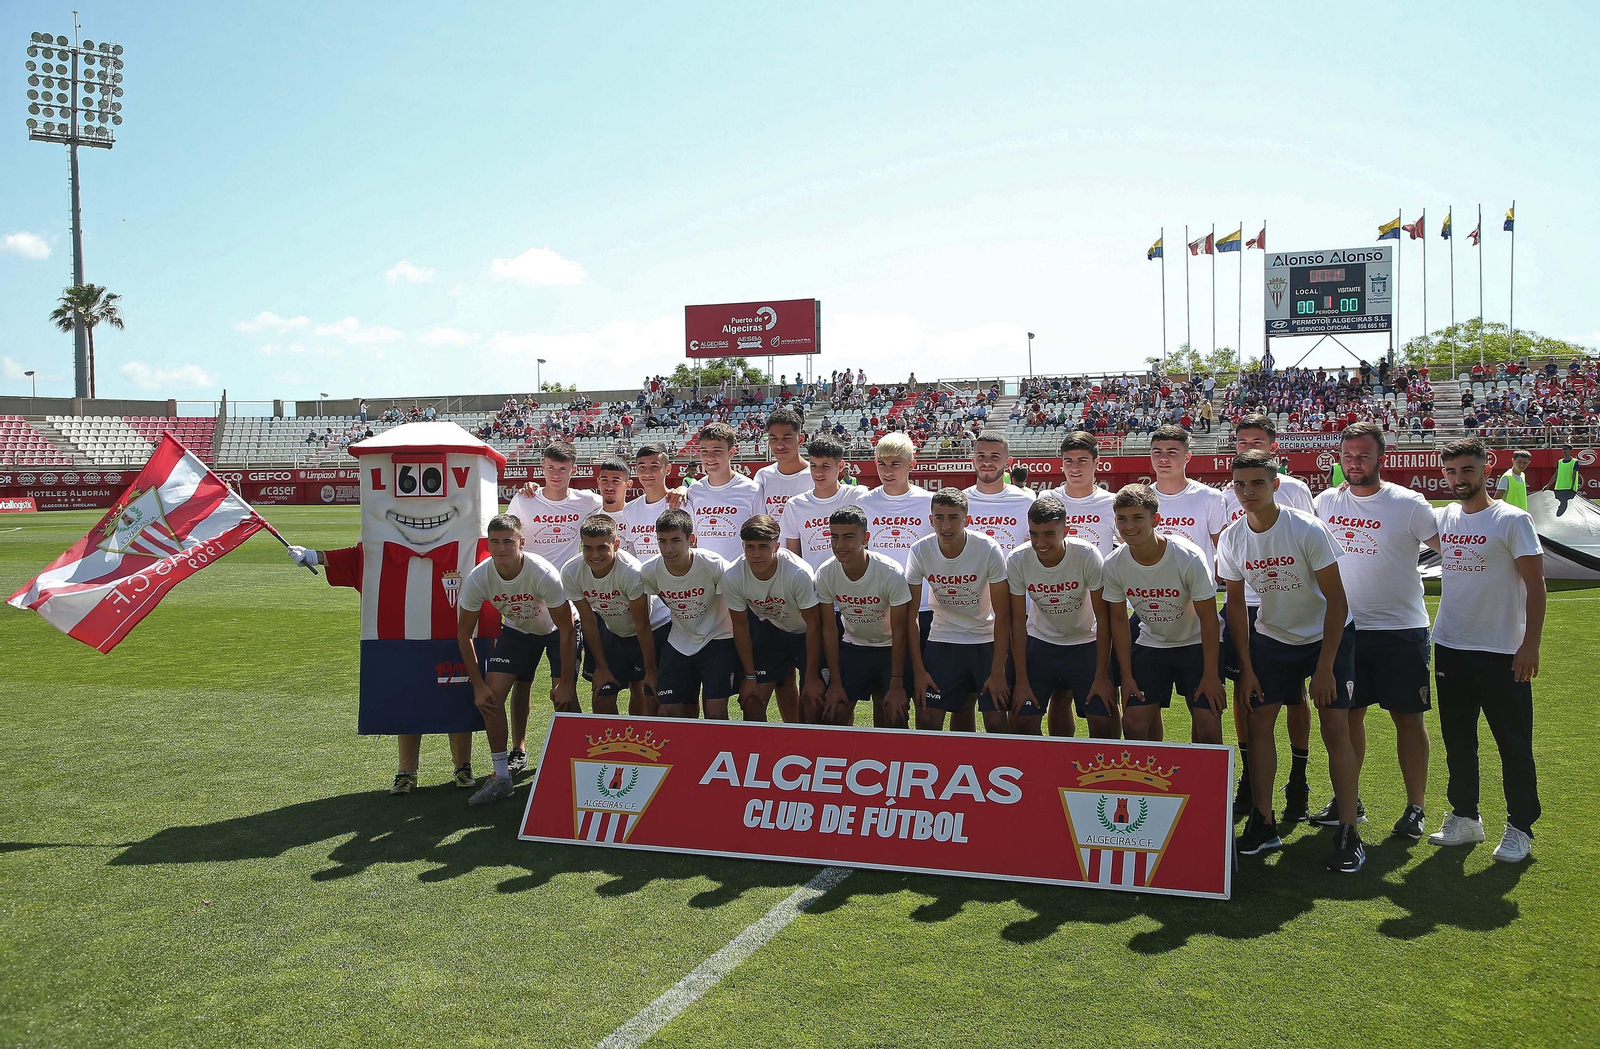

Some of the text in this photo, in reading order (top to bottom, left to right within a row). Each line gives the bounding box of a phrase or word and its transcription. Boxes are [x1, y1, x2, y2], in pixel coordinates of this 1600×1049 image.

[1273, 251, 1382, 266] Alonso Alonso
[1297, 301, 1314, 314] 00
[1340, 298, 1358, 312] 00
[1332, 315, 1372, 324] ALGECIRAS
[722, 324, 762, 334] Algeciras
[1384, 452, 1444, 468] EDERACIÓN
[248, 472, 291, 480] GEFCO
[307, 471, 336, 481] Limpiasol
[371, 468, 386, 490] L
[452, 467, 470, 488] V
[267, 487, 296, 495] caser
[696, 507, 737, 515] ASCENSO
[533, 514, 579, 523] ASCENSO
[805, 517, 829, 529] ASCE
[873, 517, 922, 525] ASCENSO
[966, 515, 1017, 525] ASCENSO
[1329, 515, 1381, 529] ASCENSO
[631, 525, 655, 533] ASCEN
[1363, 532, 1378, 547] CADETE
[1441, 533, 1486, 544] ASCENSO
[1469, 548, 1485, 563] CADETE
[1246, 556, 1294, 570] ASCENSO
[928, 574, 977, 584] ASCENSO
[1281, 570, 1300, 581] CADETE
[1028, 581, 1079, 593] ASCENSO
[660, 588, 704, 599] ASCENSO
[1126, 588, 1180, 598] ASCENSO
[835, 595, 880, 605] ASCENSO
[698, 751, 1024, 804] ALGECIRAS
[583, 800, 623, 809] ALGECIRAS
[743, 797, 968, 844] CLUB DE FÚTBOL
[1086, 835, 1154, 847] ALGECIRAS C.F.
